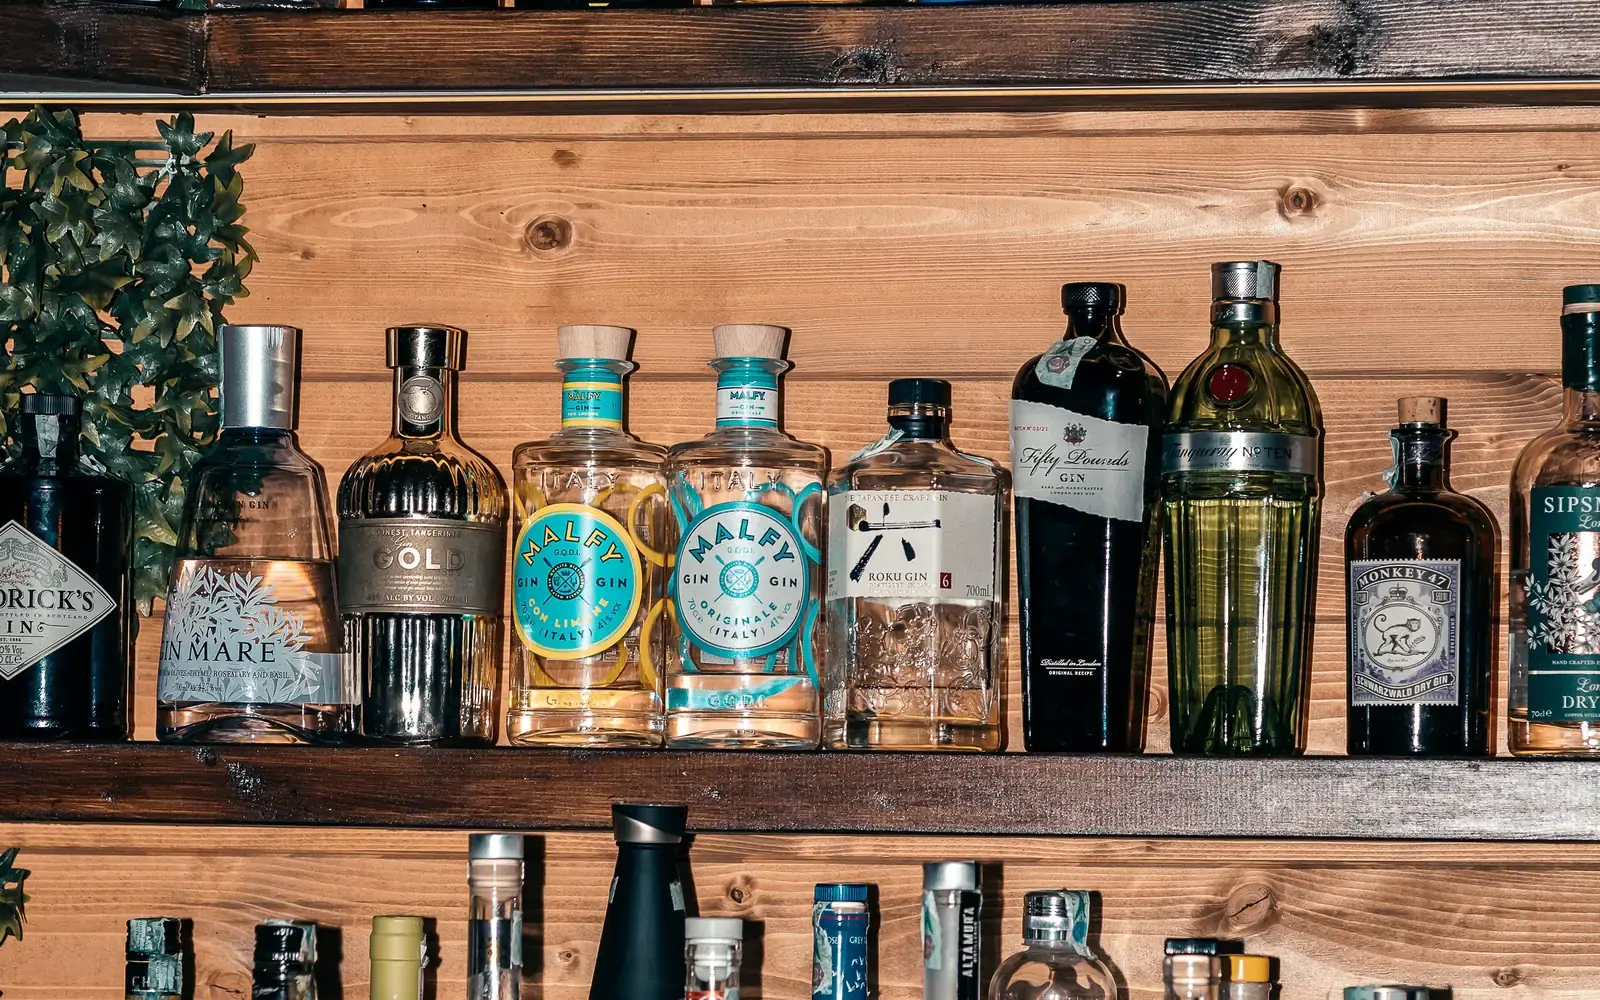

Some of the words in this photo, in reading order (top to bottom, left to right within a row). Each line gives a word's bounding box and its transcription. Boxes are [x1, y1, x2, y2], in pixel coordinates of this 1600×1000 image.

[730, 391, 766, 400] MALFY
[1019, 443, 1061, 477] Fifty
[1064, 448, 1130, 467] Pounds
[1170, 443, 1237, 462] Tanqueray
[1263, 447, 1293, 460] TEN
[541, 471, 620, 490] ITALY
[699, 470, 782, 491] ITALY
[1059, 473, 1086, 483] GIN
[249, 500, 269, 510] GIN
[858, 494, 900, 502] JAPANESE
[411, 528, 462, 538] TANGERINE
[521, 520, 625, 567] MALFY
[688, 518, 796, 564] MALFY
[372, 546, 466, 571] GOLD
[553, 548, 581, 556] G.Q.D.I.
[517, 577, 538, 588] GIN
[595, 577, 628, 588] GIN
[683, 574, 709, 585] GIN
[769, 576, 798, 588] GIN
[869, 572, 901, 582] ROKU
[904, 572, 928, 582] GIN
[942, 574, 950, 588] 6
[1358, 567, 1427, 588] MONKEY
[1428, 573, 1447, 586] 47
[403, 594, 415, 602] BY
[416, 594, 434, 602] VOL
[528, 597, 549, 623] CON
[553, 597, 609, 628] LIMONE
[700, 600, 778, 626] ORIGINALE
[538, 627, 593, 642] (ITALY)
[709, 625, 765, 640] (ITALY)
[187, 640, 277, 664] MARE
[1076, 658, 1102, 667] London
[213, 670, 251, 678] ROSEMARY
[252, 671, 267, 679] AND
[1356, 675, 1413, 698] SCHWARZWALD
[1414, 679, 1434, 694] DRY
[1433, 675, 1449, 688] GIN
[1562, 695, 1600, 709] DRY
[962, 907, 975, 977] ALTAMURA
